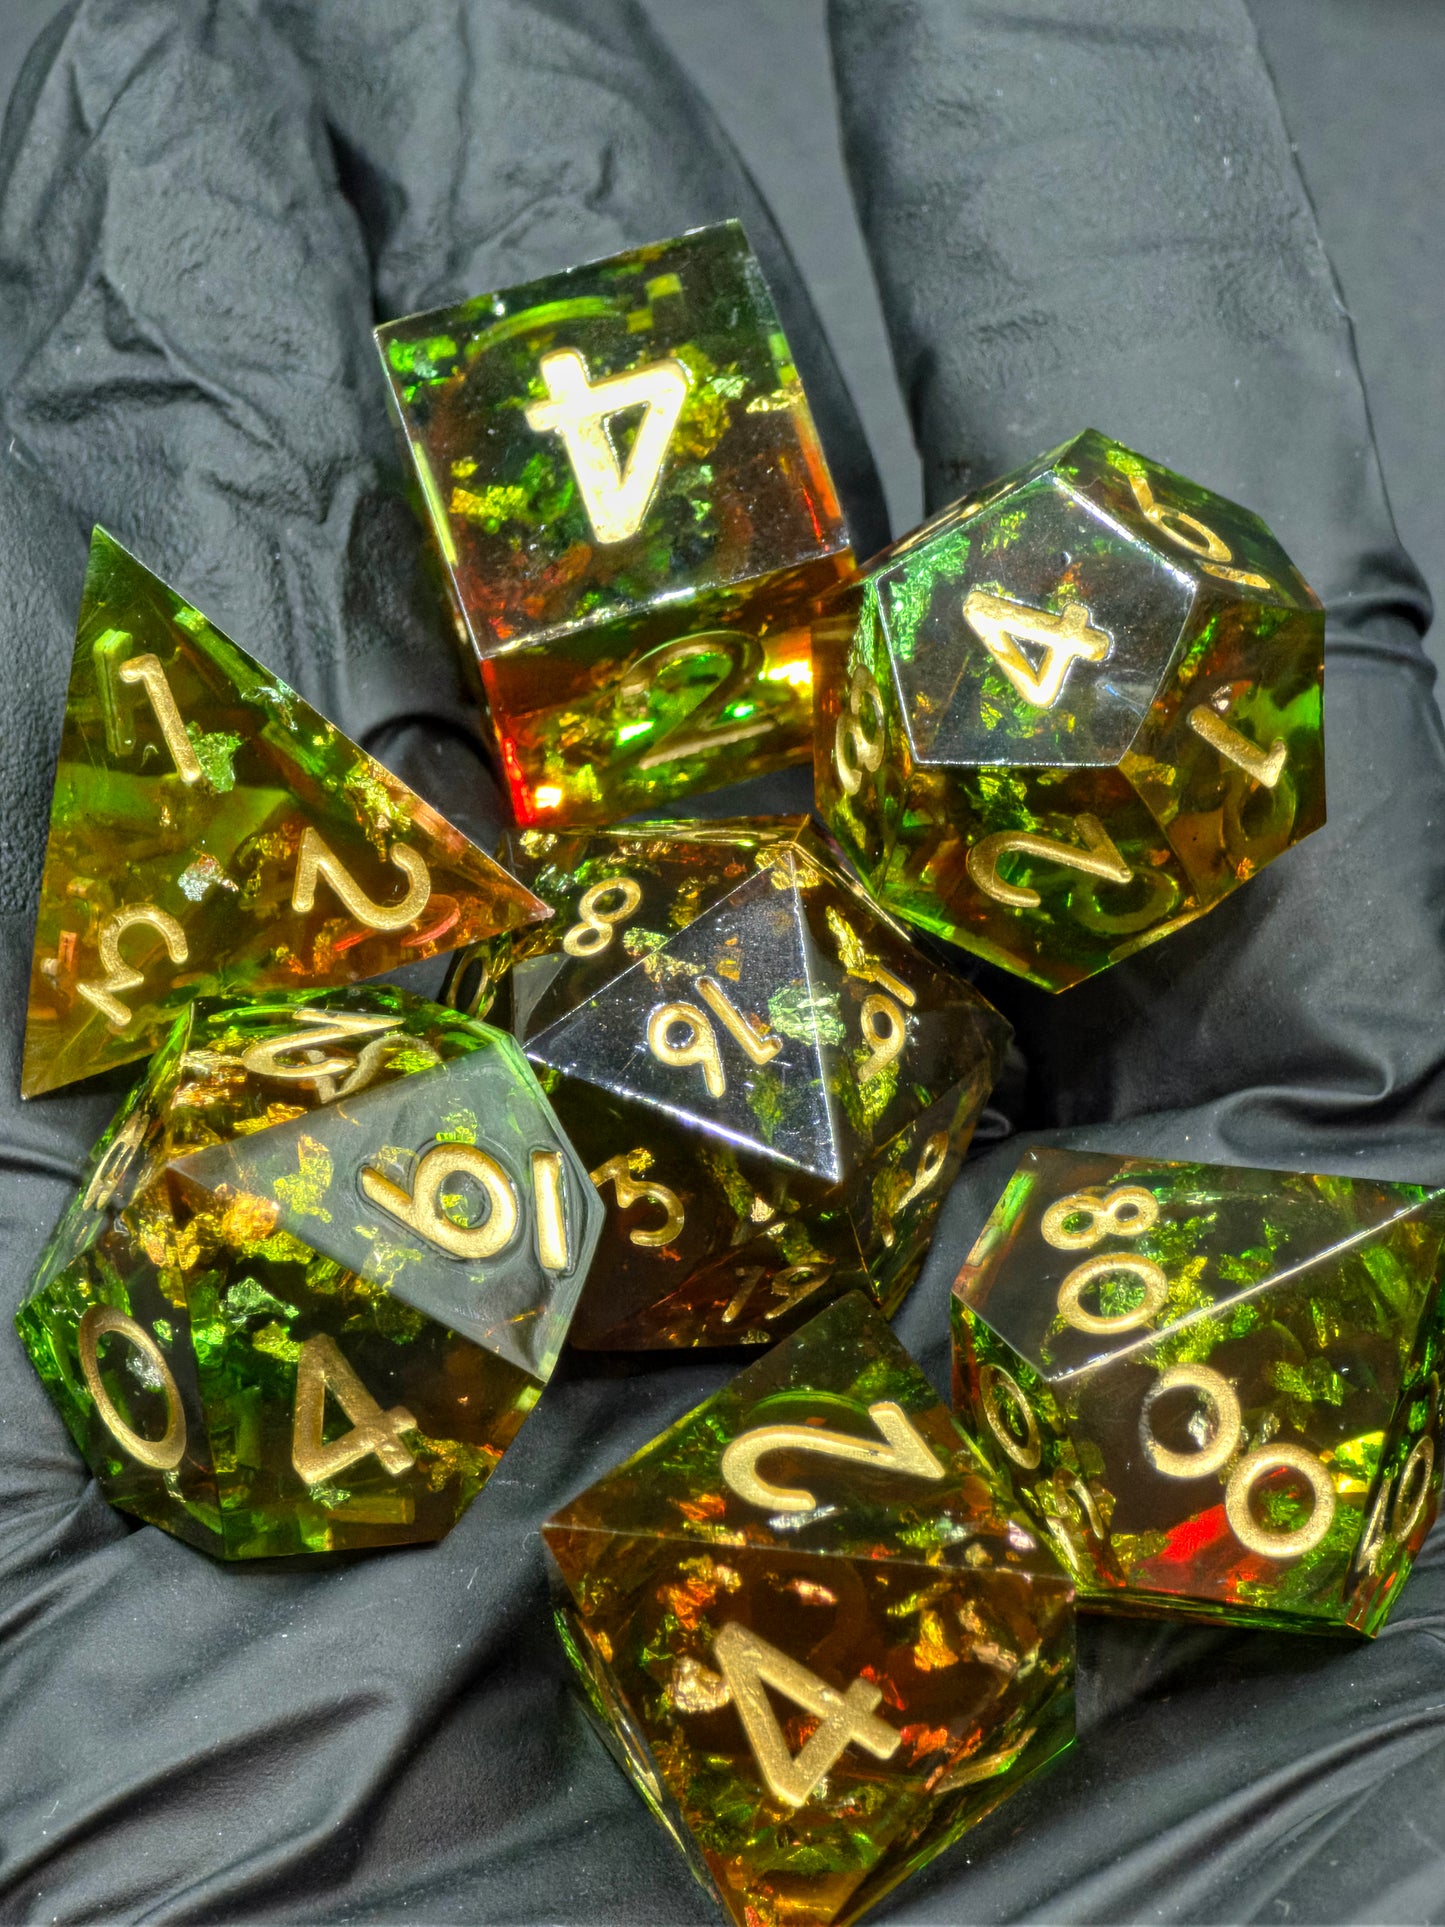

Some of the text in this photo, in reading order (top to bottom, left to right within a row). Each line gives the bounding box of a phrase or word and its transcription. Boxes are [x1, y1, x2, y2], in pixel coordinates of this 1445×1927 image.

[523, 346, 692, 545] 4
[615, 630, 776, 771] 2
[963, 588, 1116, 709] 4
[119, 652, 201, 784] 1
[1186, 702, 1289, 789] 1
[291, 826, 432, 931] 2
[563, 876, 642, 957] 8
[966, 812, 1135, 908] 2
[76, 903, 189, 1026] 3
[647, 975, 783, 1099] 16
[1040, 1184, 1170, 1336] 80
[78, 1303, 188, 1471] 0
[291, 1332, 418, 1485] 4
[721, 1401, 946, 1511] 2
[1138, 1362, 1337, 1560] 00
[713, 1621, 902, 1808] 4
